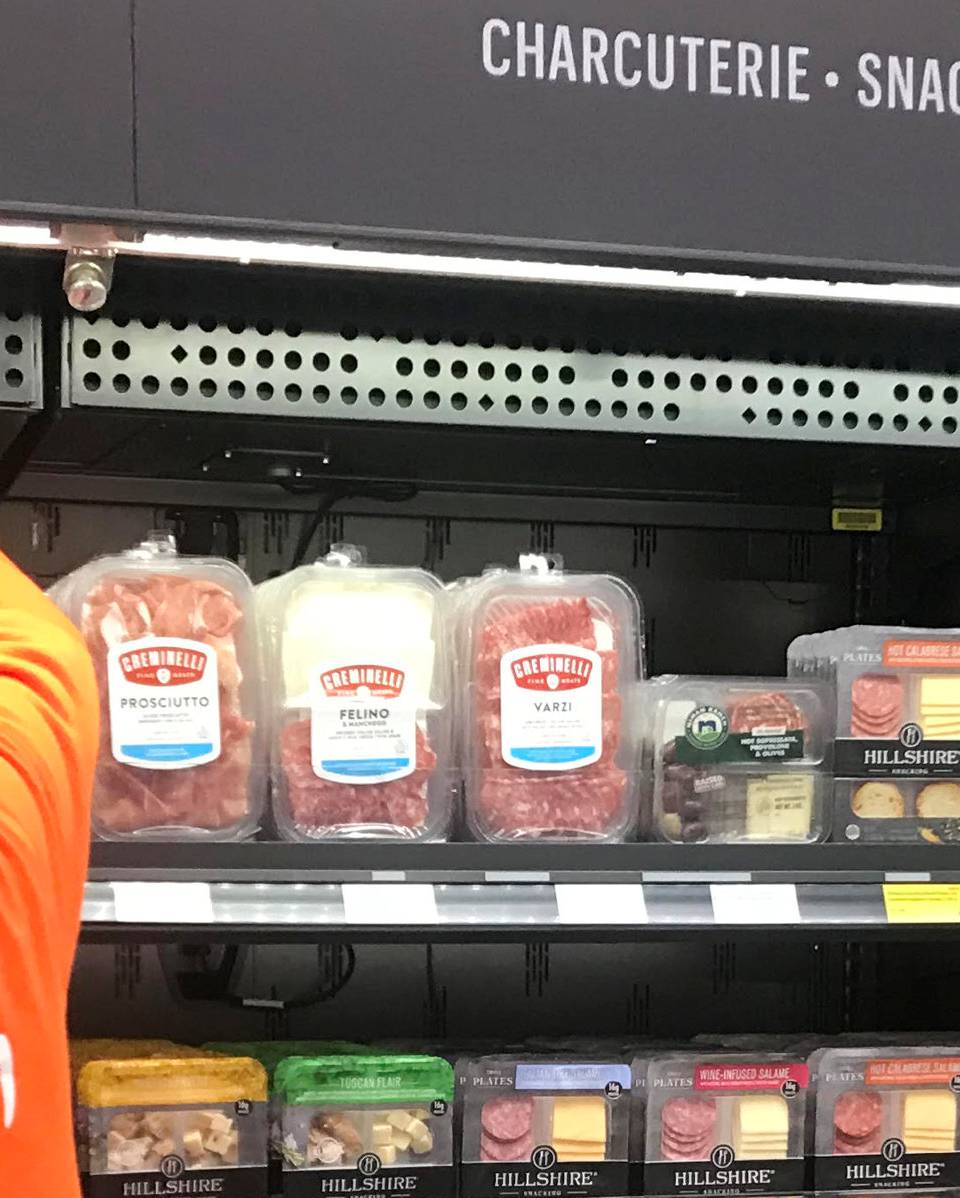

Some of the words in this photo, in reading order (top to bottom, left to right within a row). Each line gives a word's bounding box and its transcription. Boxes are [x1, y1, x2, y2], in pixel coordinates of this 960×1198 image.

[481, 17, 810, 102] CHARCUTERIE
[121, 650, 205, 673] CREMINELLI
[511, 656, 591, 679] CREMINELLI
[322, 668, 403, 693] CREMINELLI
[120, 696, 211, 709] PROSCIUTTO
[534, 702, 572, 712] VARZI
[339, 708, 390, 720] FELINO
[863, 750, 960, 765] HILLSHIRE
[472, 1076, 513, 1086] PLATES
[699, 1068, 757, 1080] WINE-INFUSED
[758, 1067, 791, 1080] SALAME
[825, 1072, 865, 1082] PLATES
[339, 1077, 375, 1089] TUSCAN
[377, 1076, 401, 1088] FLAIR
[653, 1077, 693, 1088] PLATES
[674, 1169, 772, 1186] HILLSHIRE
[846, 1163, 942, 1179] HILLSHIRE
[321, 1176, 417, 1193] HILLSHIRE
[494, 1171, 595, 1187] HILLSHIRE
[123, 1178, 224, 1196] HILLSHIRE
